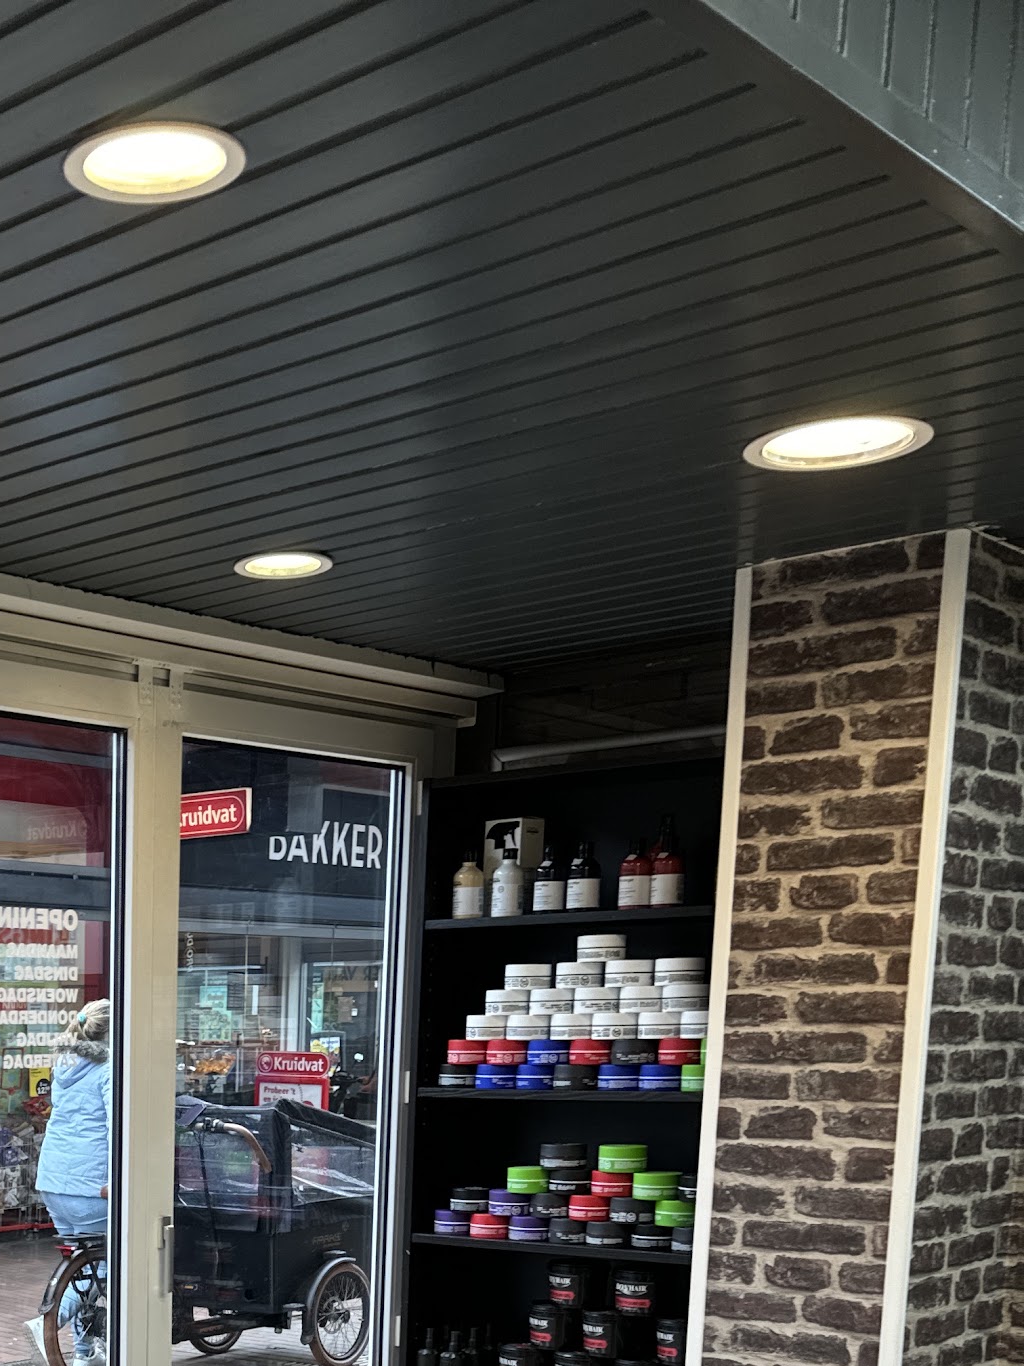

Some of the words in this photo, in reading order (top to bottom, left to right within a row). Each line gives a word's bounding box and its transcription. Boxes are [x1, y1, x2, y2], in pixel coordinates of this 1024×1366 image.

[180, 804, 238, 828] ruidvat
[273, 1056, 325, 1073] Kruidvat
[263, 1085, 290, 1095] Probeer
